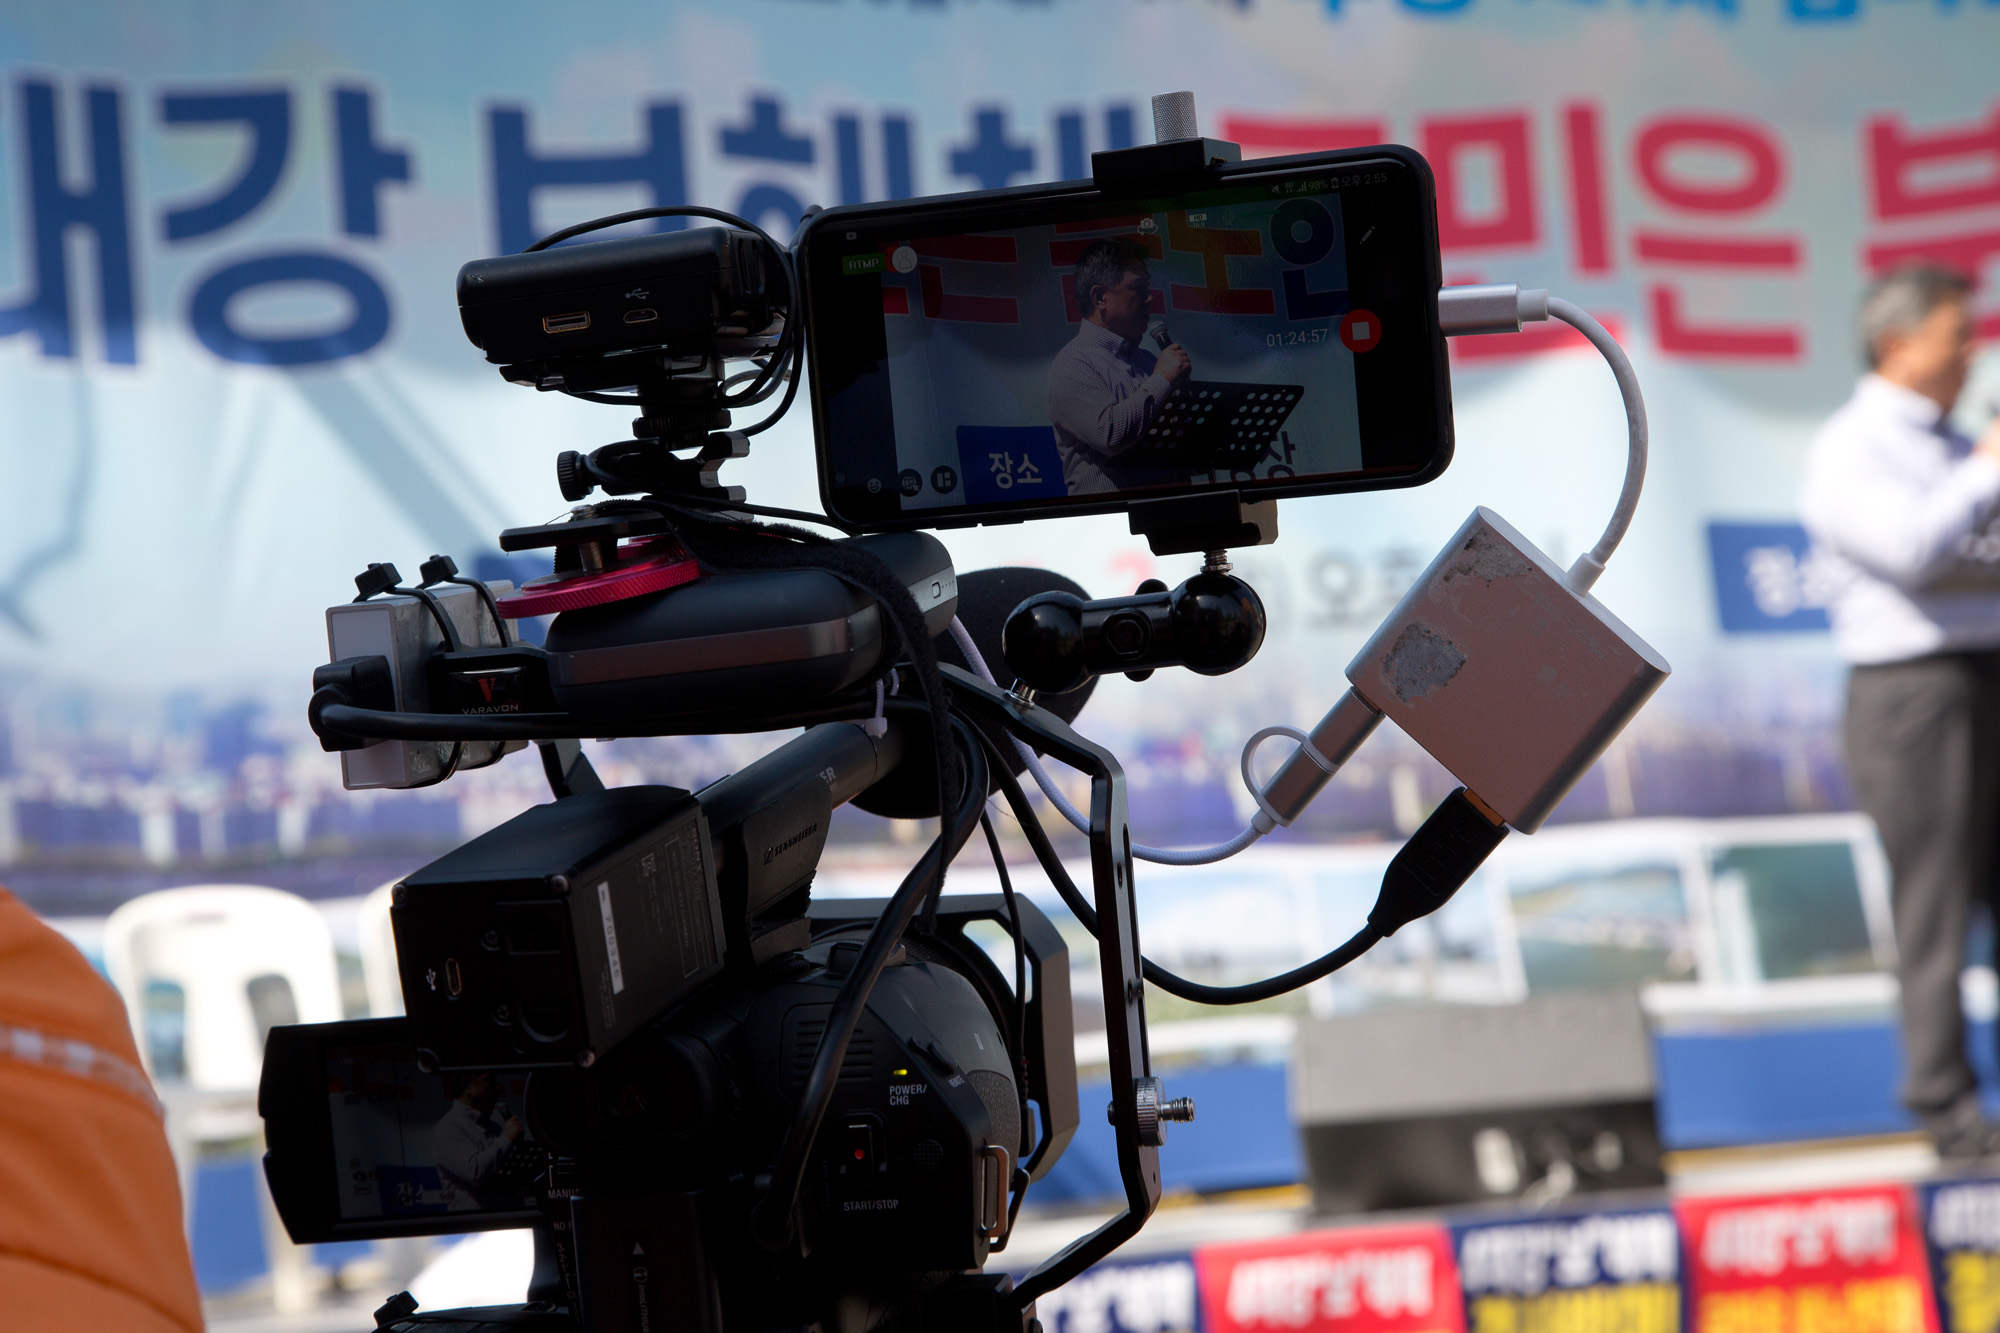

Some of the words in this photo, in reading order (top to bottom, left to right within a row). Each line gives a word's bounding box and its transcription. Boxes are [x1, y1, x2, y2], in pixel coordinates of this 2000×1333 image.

[1308, 180, 1328, 191] 98%
[1341, 174, 1362, 188] 오후
[1364, 172, 1388, 185] 2:55
[1222, 103, 1806, 362] 민은
[848, 258, 879, 271] RTMP
[1265, 328, 1328, 347] 01:24:57
[987, 449, 1044, 490] 장소
[461, 703, 520, 715] VARAVON
[774, 823, 818, 857] SENNHEISER
[889, 1083, 928, 1096] POWER/
[889, 1095, 910, 1106] CHG
[842, 1199, 900, 1212] START/STOP
